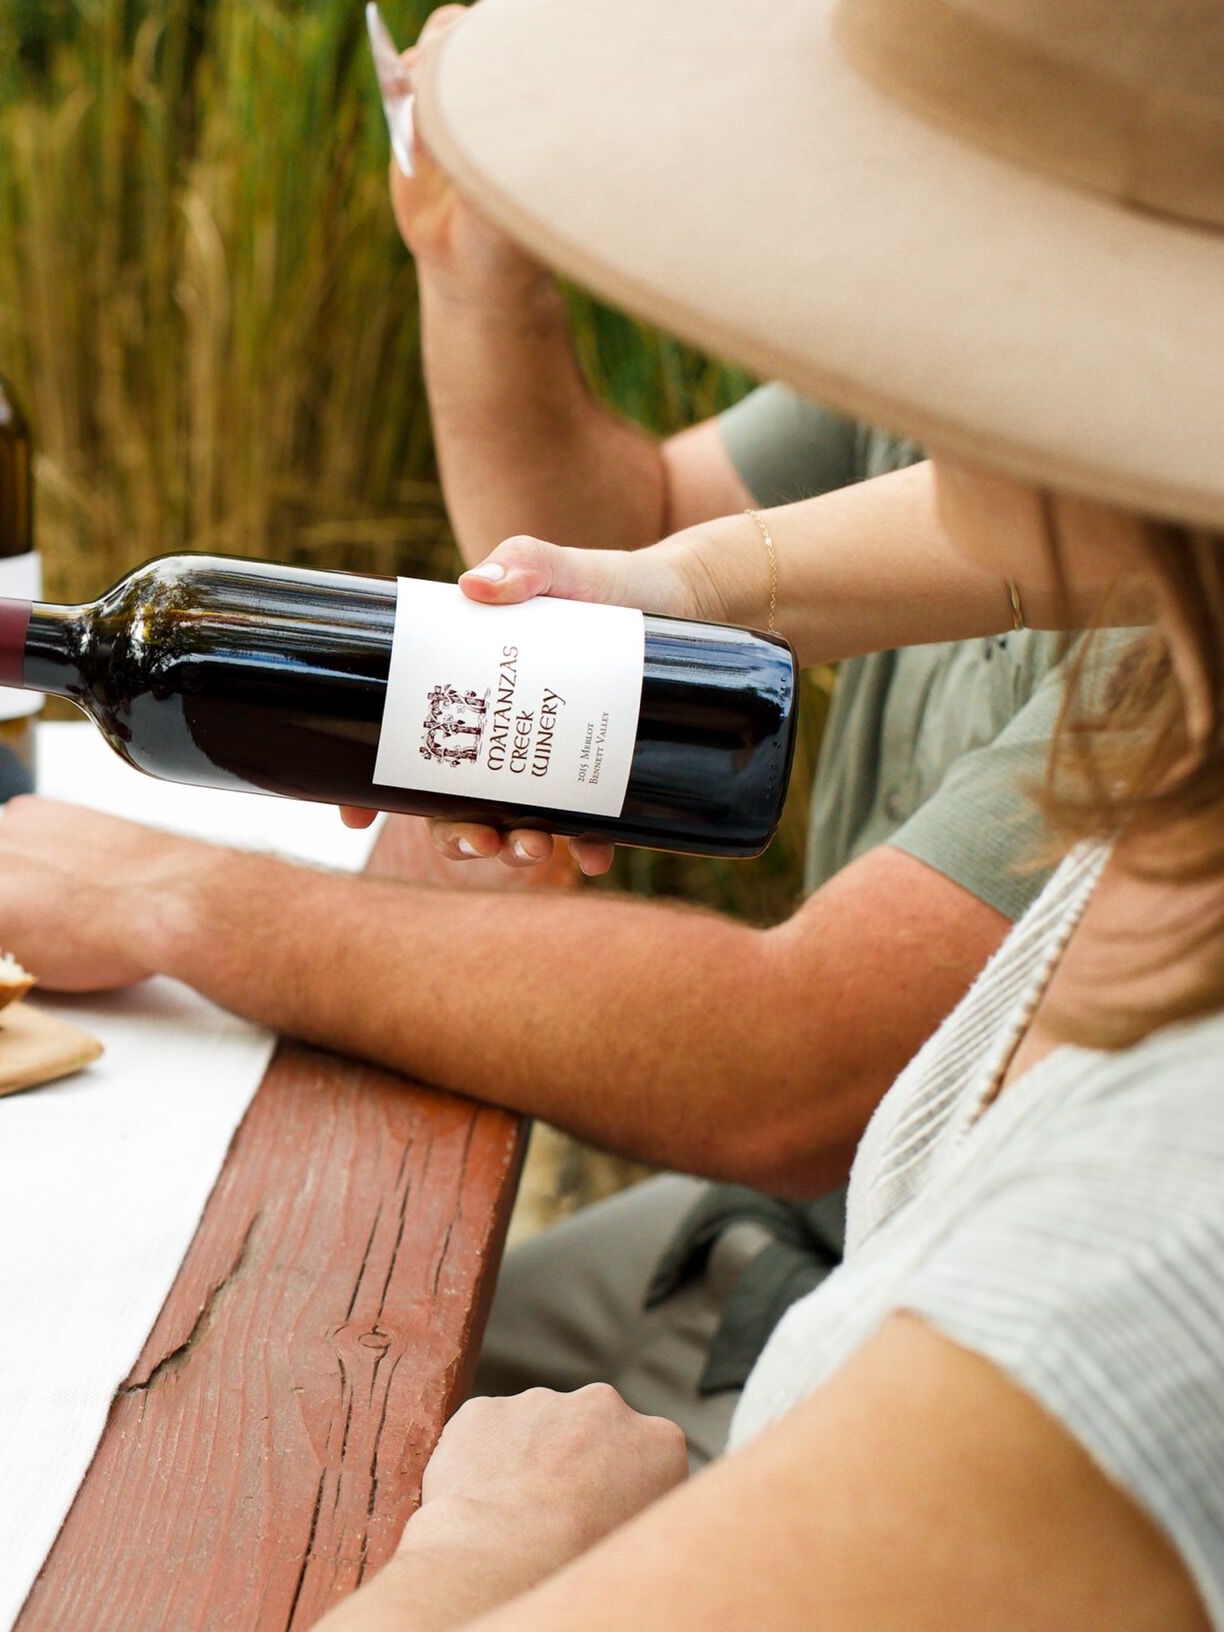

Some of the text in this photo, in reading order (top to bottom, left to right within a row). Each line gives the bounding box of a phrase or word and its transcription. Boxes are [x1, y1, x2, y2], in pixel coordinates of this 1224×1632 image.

[487, 645, 518, 771] MATANZAS
[531, 688, 566, 778] WINERY
[578, 764, 589, 782] 2015
